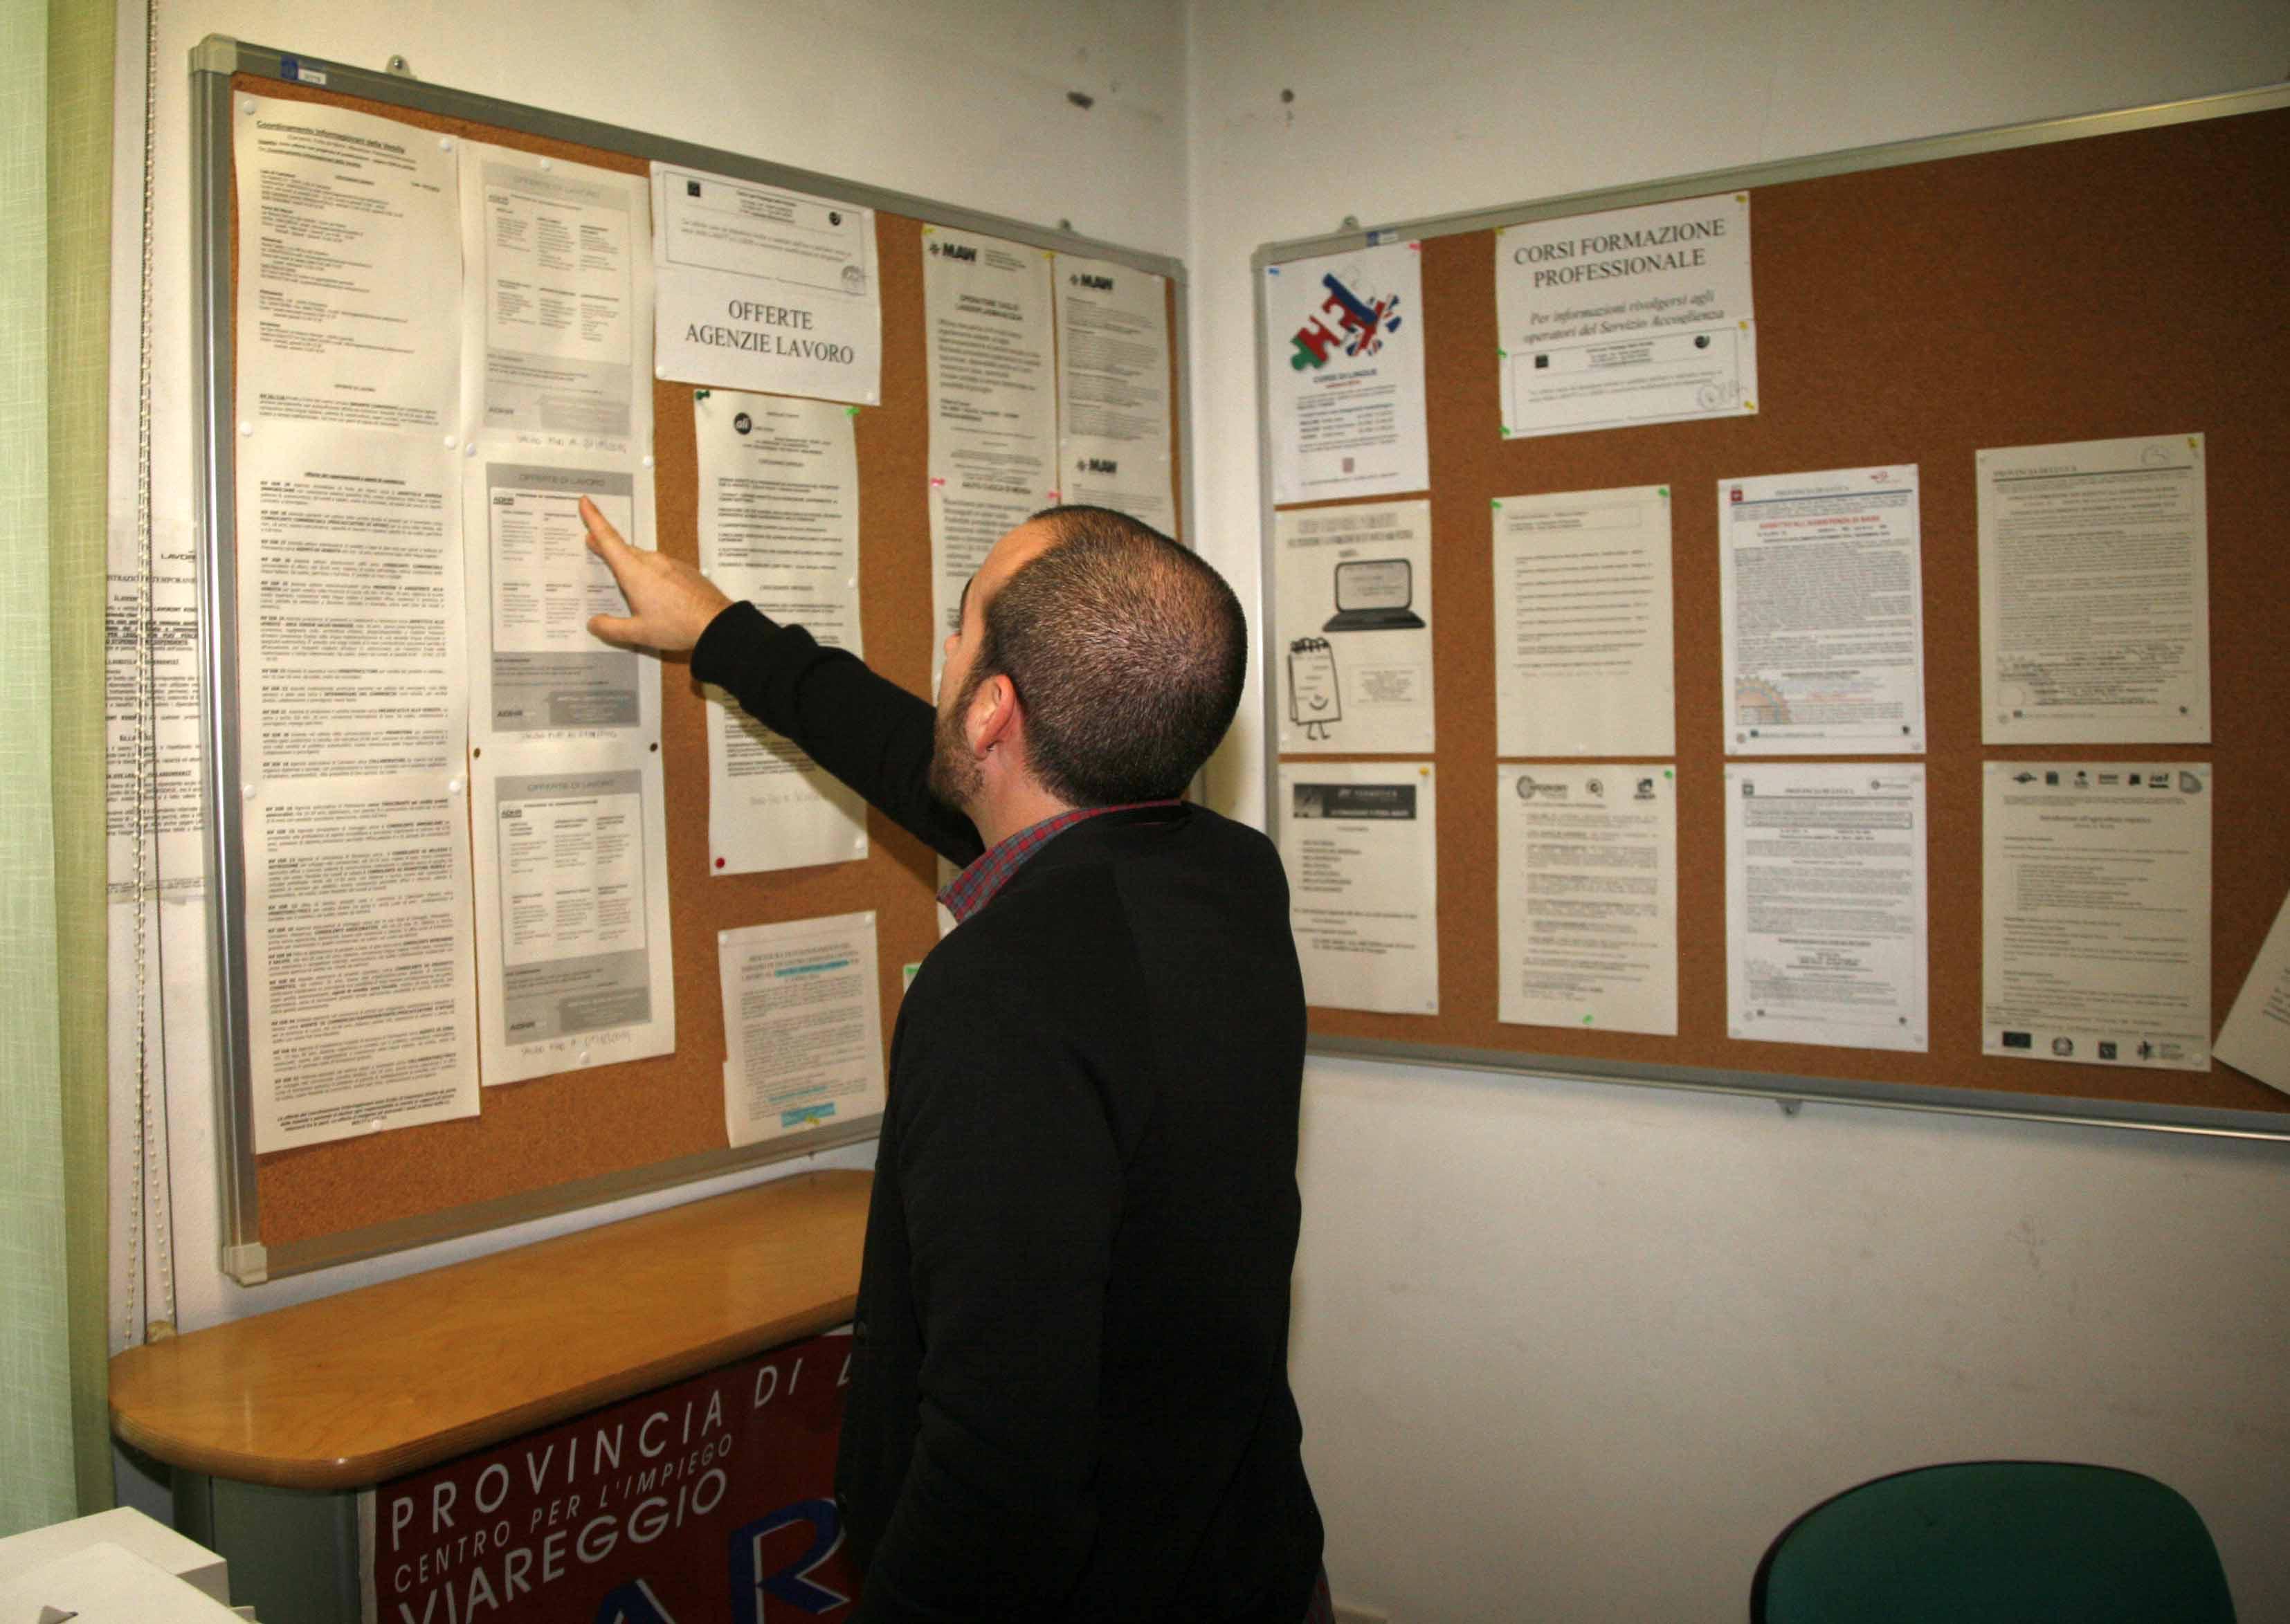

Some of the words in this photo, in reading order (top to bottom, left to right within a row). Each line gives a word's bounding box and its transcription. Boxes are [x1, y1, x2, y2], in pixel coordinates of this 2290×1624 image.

[1514, 240, 1575, 265] CORSI
[1580, 218, 1726, 255] FORMAZIONE
[1534, 247, 1707, 288] PROFESSIONALE
[728, 299, 814, 331] OFFERTE
[1524, 328, 1576, 345] operatori
[1579, 323, 1597, 337] del
[1600, 320, 1648, 334] Servizio
[1652, 309, 1725, 327] Accoglienza
[1529, 311, 1550, 326] Per
[1552, 304, 1626, 323] informazioni
[1629, 295, 1688, 311] rivolgersi
[1689, 289, 1715, 306] agli
[685, 322, 772, 354] AGENZIE
[775, 336, 854, 365] LAVORO
[392, 1389, 722, 1552] PROVINCIA
[754, 1358, 803, 1409] DI
[394, 1520, 510, 1593] CENTRO
[529, 1494, 581, 1534] PER
[599, 1433, 732, 1508] L'IMPIEGO
[398, 1468, 727, 1624] VIAREGGIO
